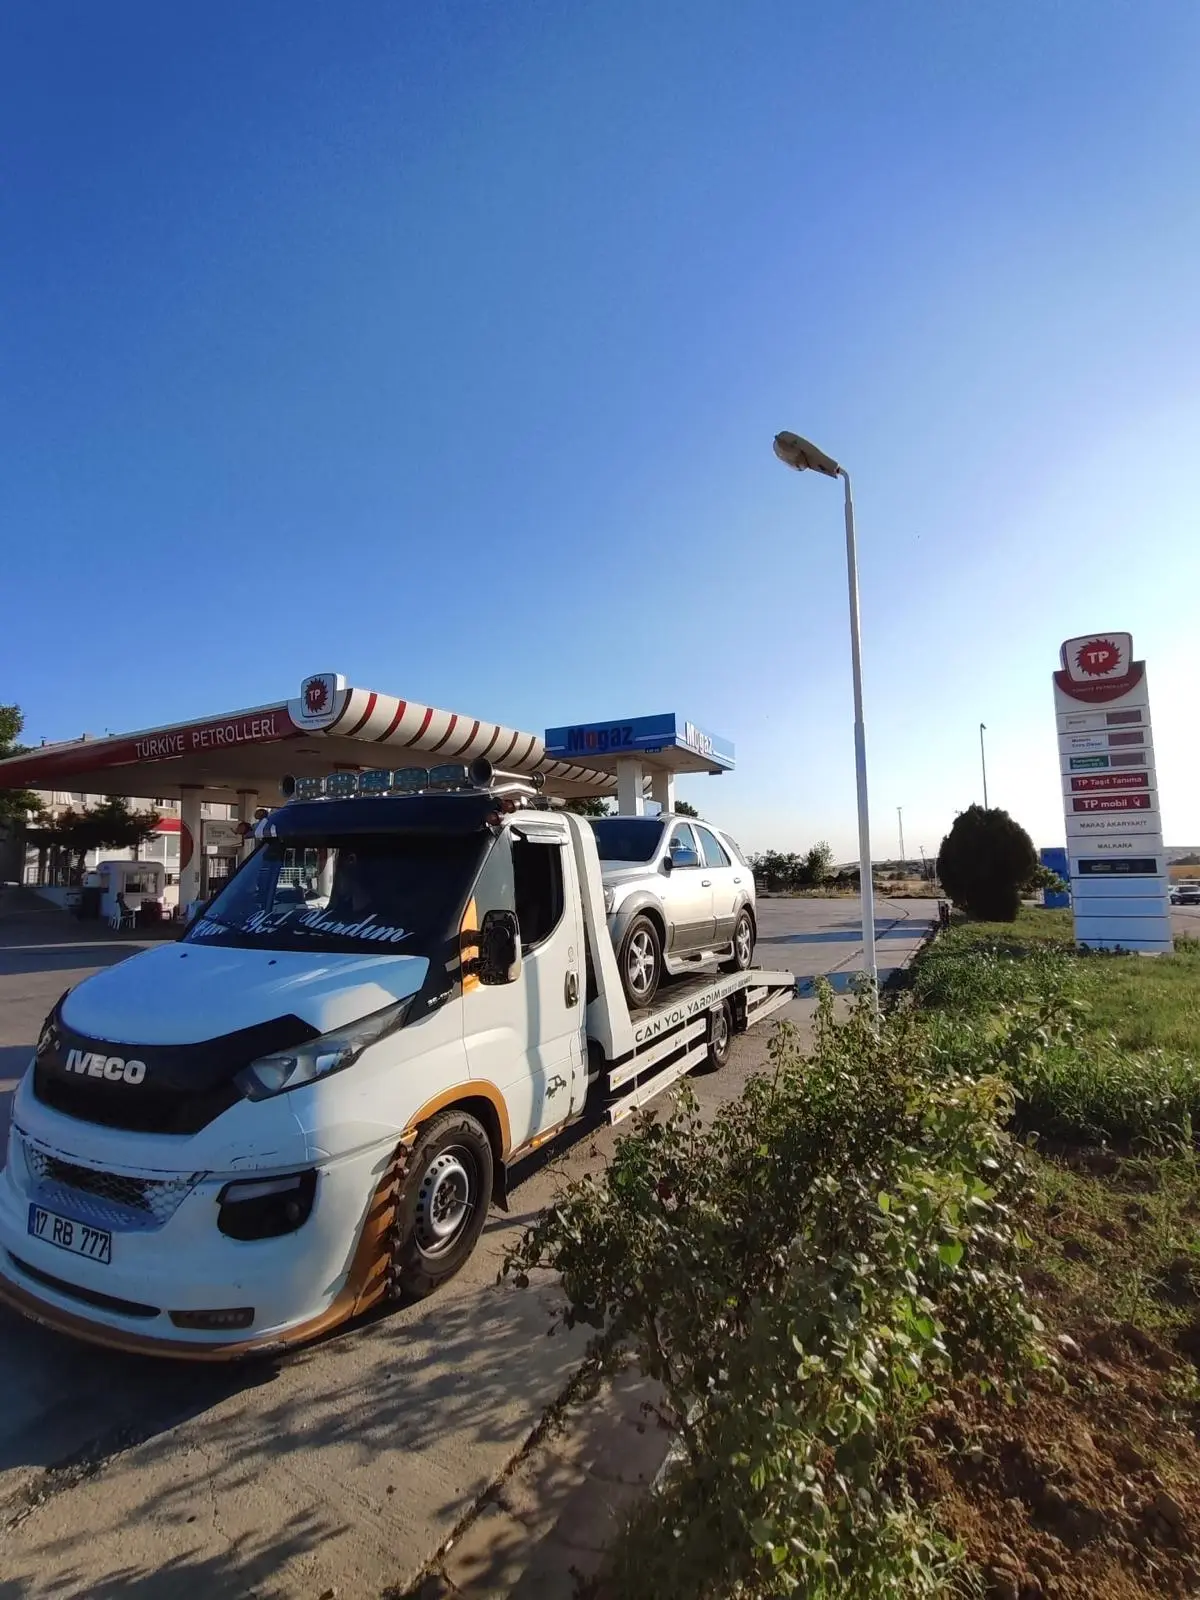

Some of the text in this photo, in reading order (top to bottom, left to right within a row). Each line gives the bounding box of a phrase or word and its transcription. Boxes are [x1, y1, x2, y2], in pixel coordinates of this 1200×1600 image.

[1087, 650, 1110, 664] TP
[309, 689, 321, 701] TP
[135, 714, 277, 759] TÜRKİYE PETROLLERİ
[567, 726, 634, 752] Mogaz
[685, 721, 714, 756] Mogaz
[1082, 798, 1127, 809] TP mobil
[635, 988, 721, 1043] CAN YOL YARDIM
[65, 1048, 147, 1085] IVECO
[34, 1208, 109, 1259] 17 RB 777
